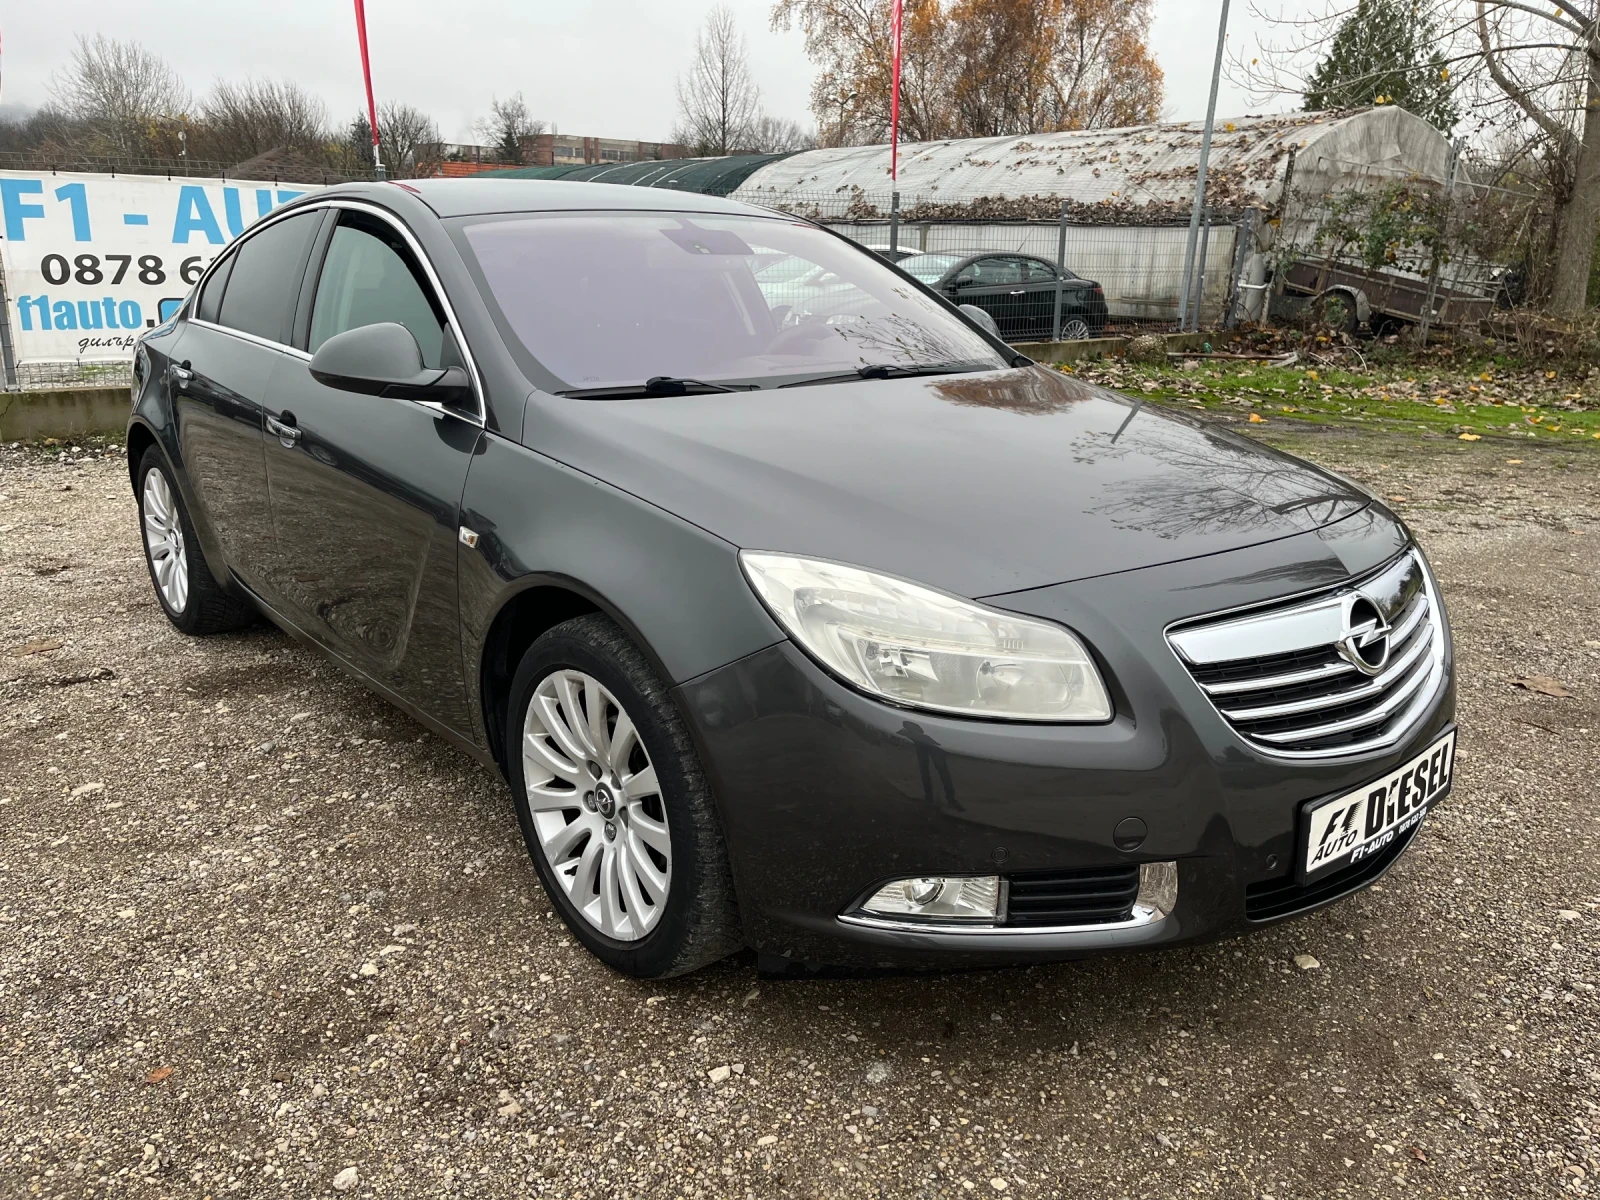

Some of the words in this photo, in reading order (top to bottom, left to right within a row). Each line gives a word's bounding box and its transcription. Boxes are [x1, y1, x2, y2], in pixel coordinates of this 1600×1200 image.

[0, 179, 92, 242] F1
[41, 254, 166, 285] 0878
[179, 256, 215, 285] 6
[78, 335, 135, 353] дилър
[1364, 743, 1448, 840] DIESEL
[1311, 830, 1357, 865] AUTO
